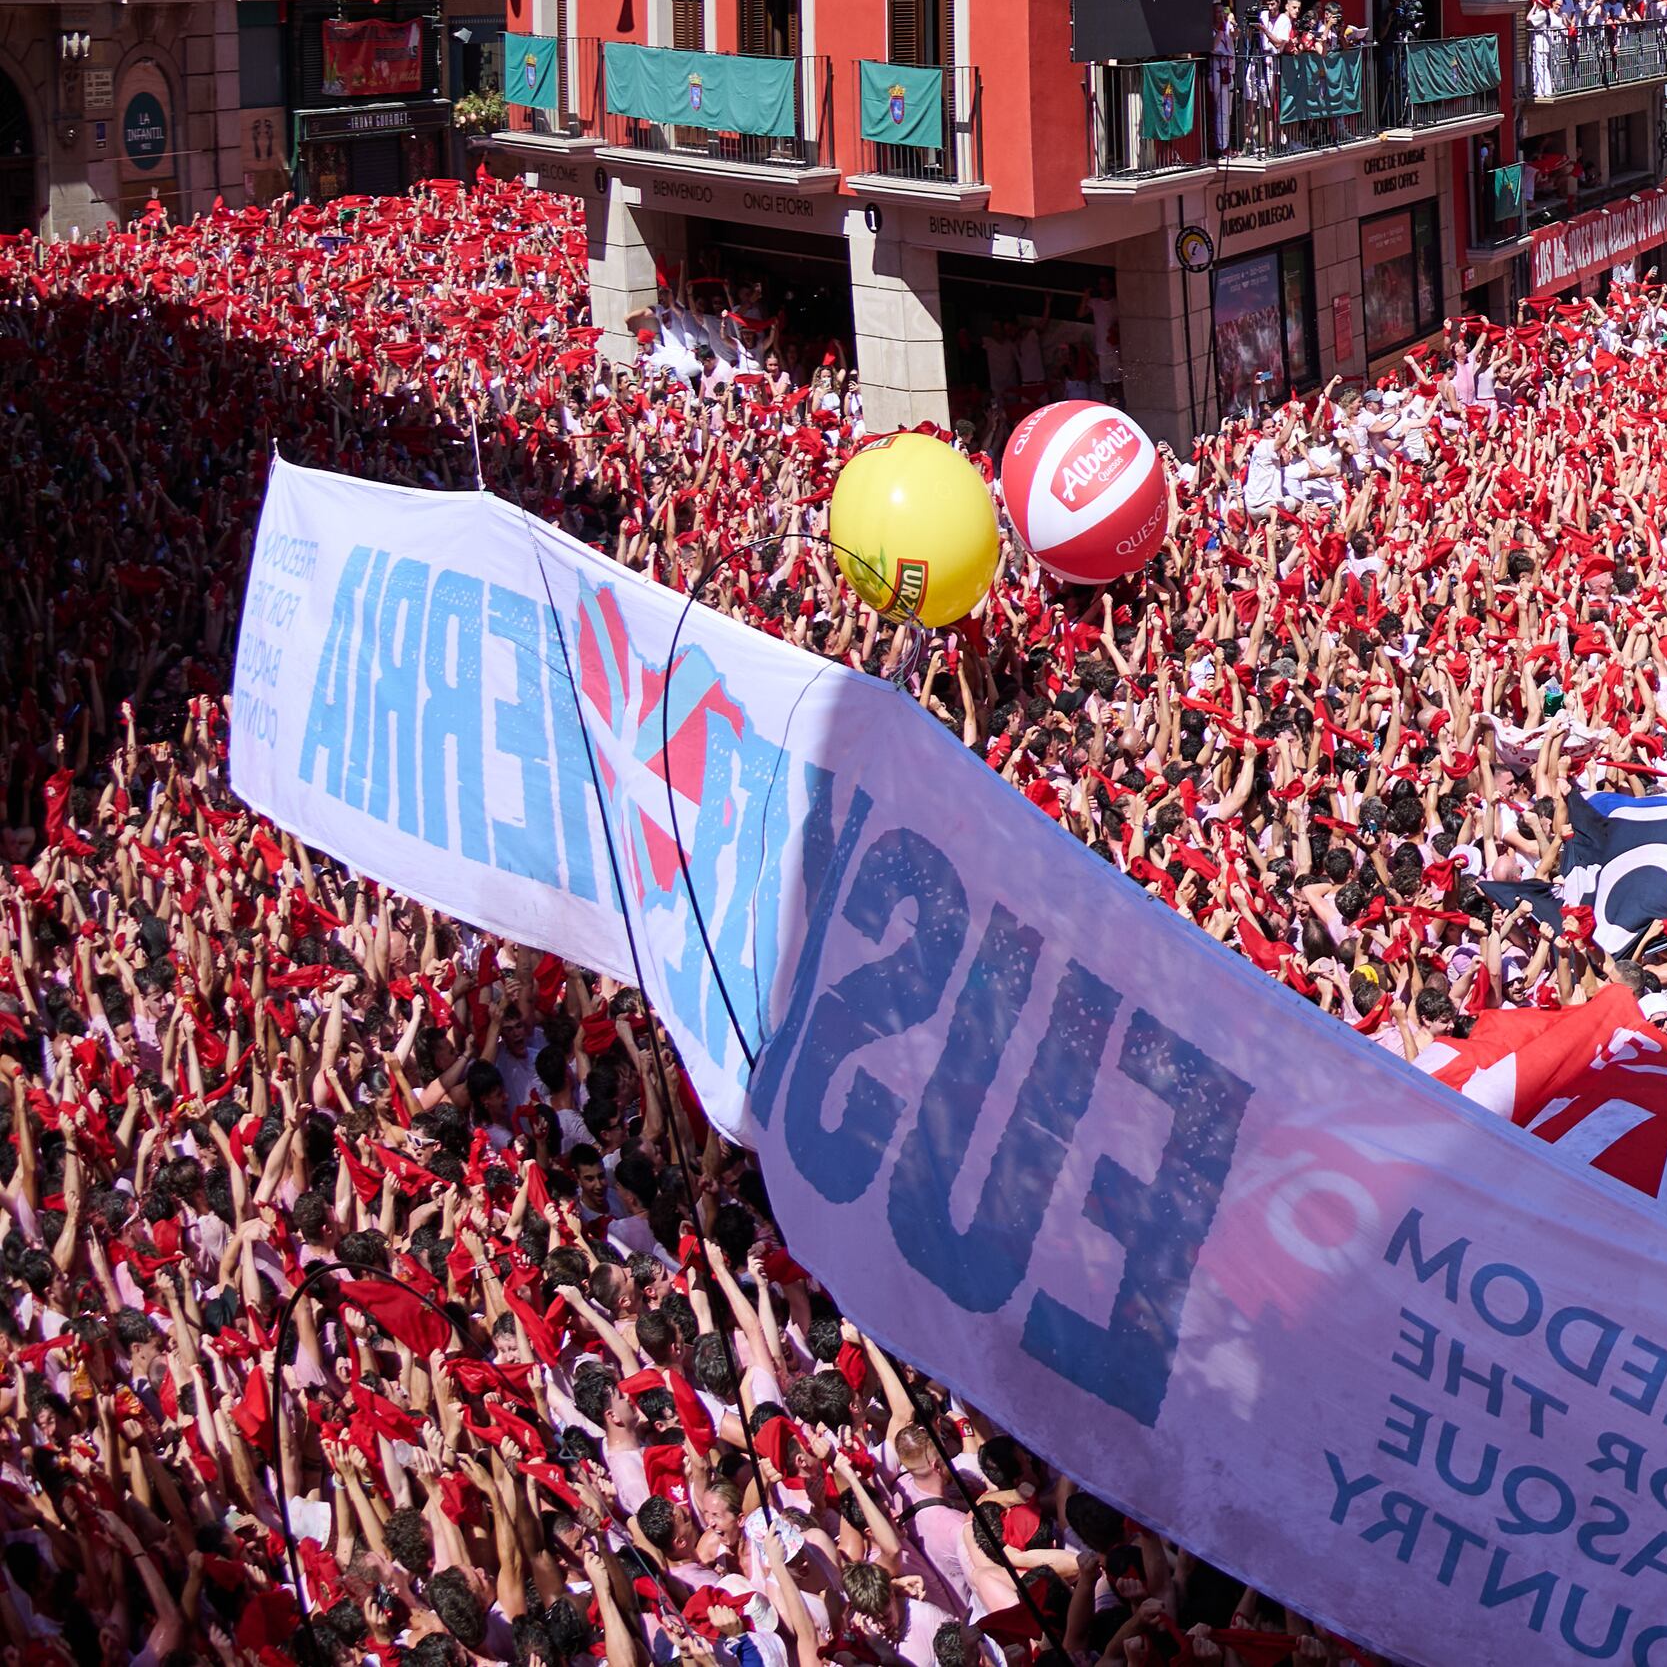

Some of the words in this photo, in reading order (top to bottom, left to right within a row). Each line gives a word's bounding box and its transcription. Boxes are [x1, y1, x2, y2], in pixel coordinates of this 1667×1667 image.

[138, 113, 151, 125] LA
[127, 127, 165, 141] INFANTIL
[1364, 153, 1389, 175] OFFICE
[652, 178, 713, 203] BIENVENIDO
[1251, 186, 1264, 203] DE
[1263, 177, 1298, 200] TURISMO
[743, 191, 775, 215] ONGI
[775, 196, 814, 218] ETORRI
[929, 215, 1000, 242] BIENVENUE
[1535, 239, 1552, 287] LOS
[1062, 424, 1134, 502] Albéniz
[1115, 494, 1167, 555] QUESOS
